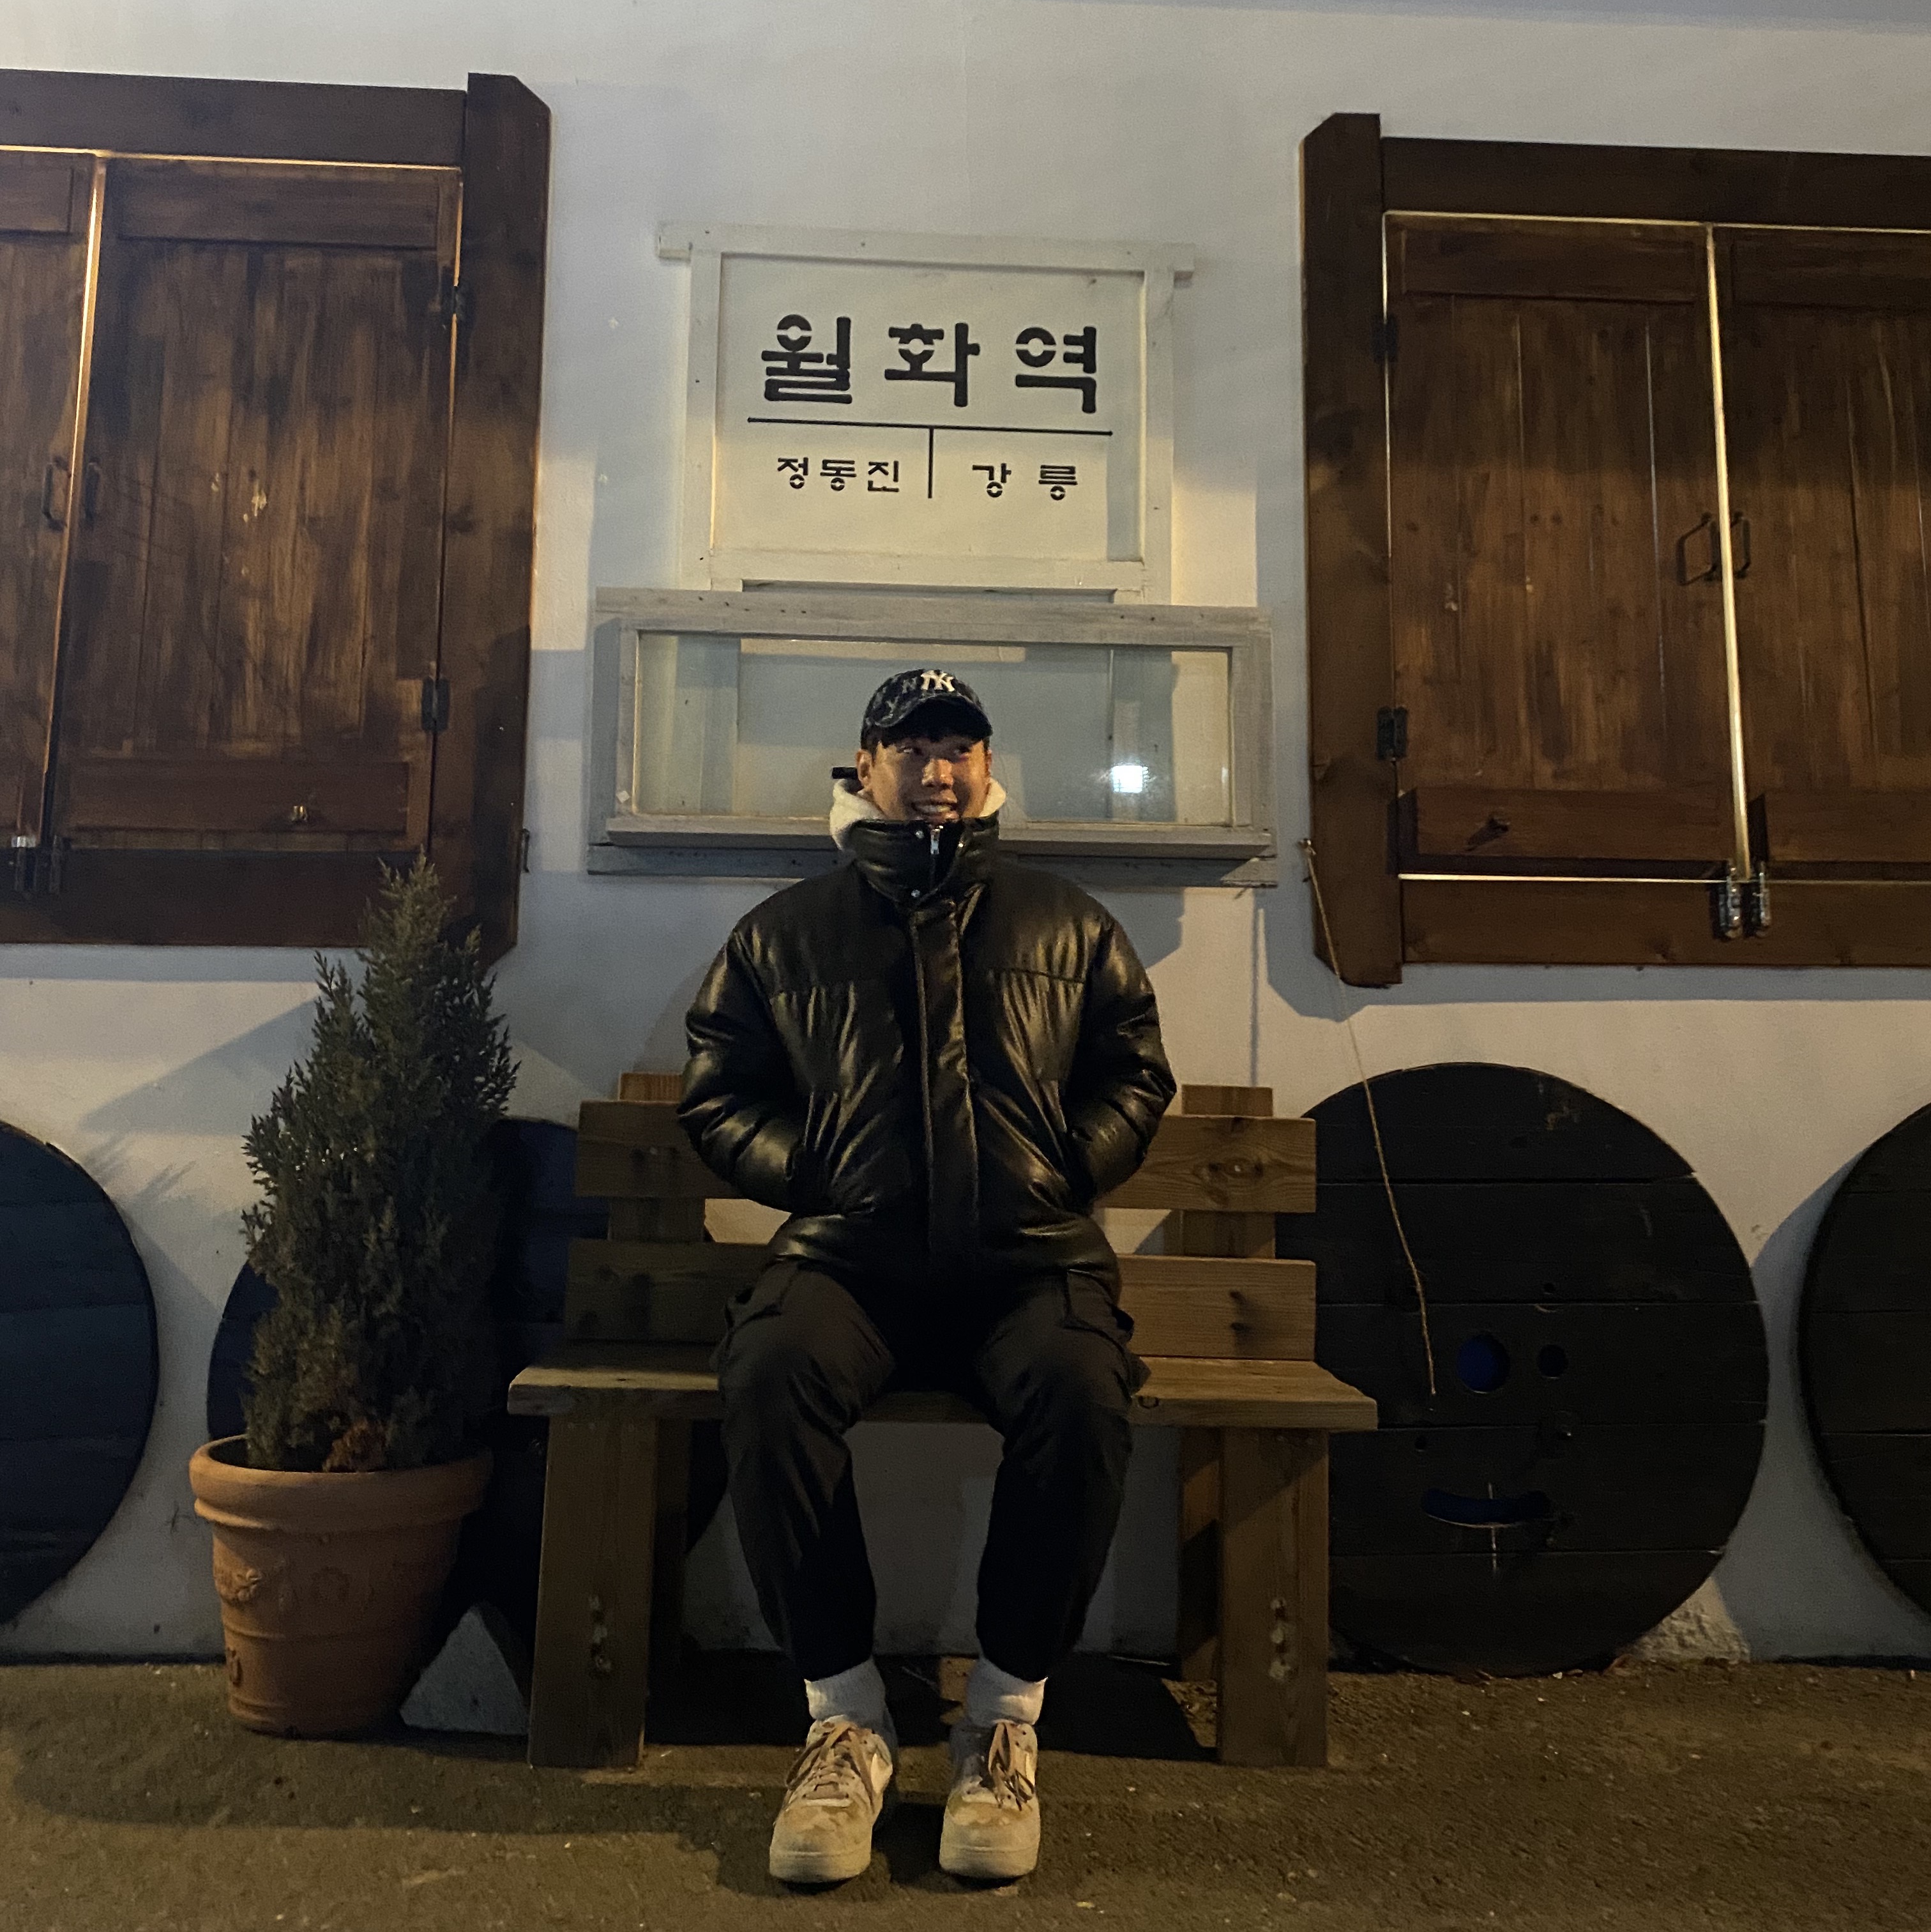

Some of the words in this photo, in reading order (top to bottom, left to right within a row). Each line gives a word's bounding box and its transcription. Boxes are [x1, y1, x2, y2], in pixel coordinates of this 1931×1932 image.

[761, 314, 1097, 414] 월화역
[776, 457, 900, 493] 정동진
[972, 463, 1079, 501] 강릉
